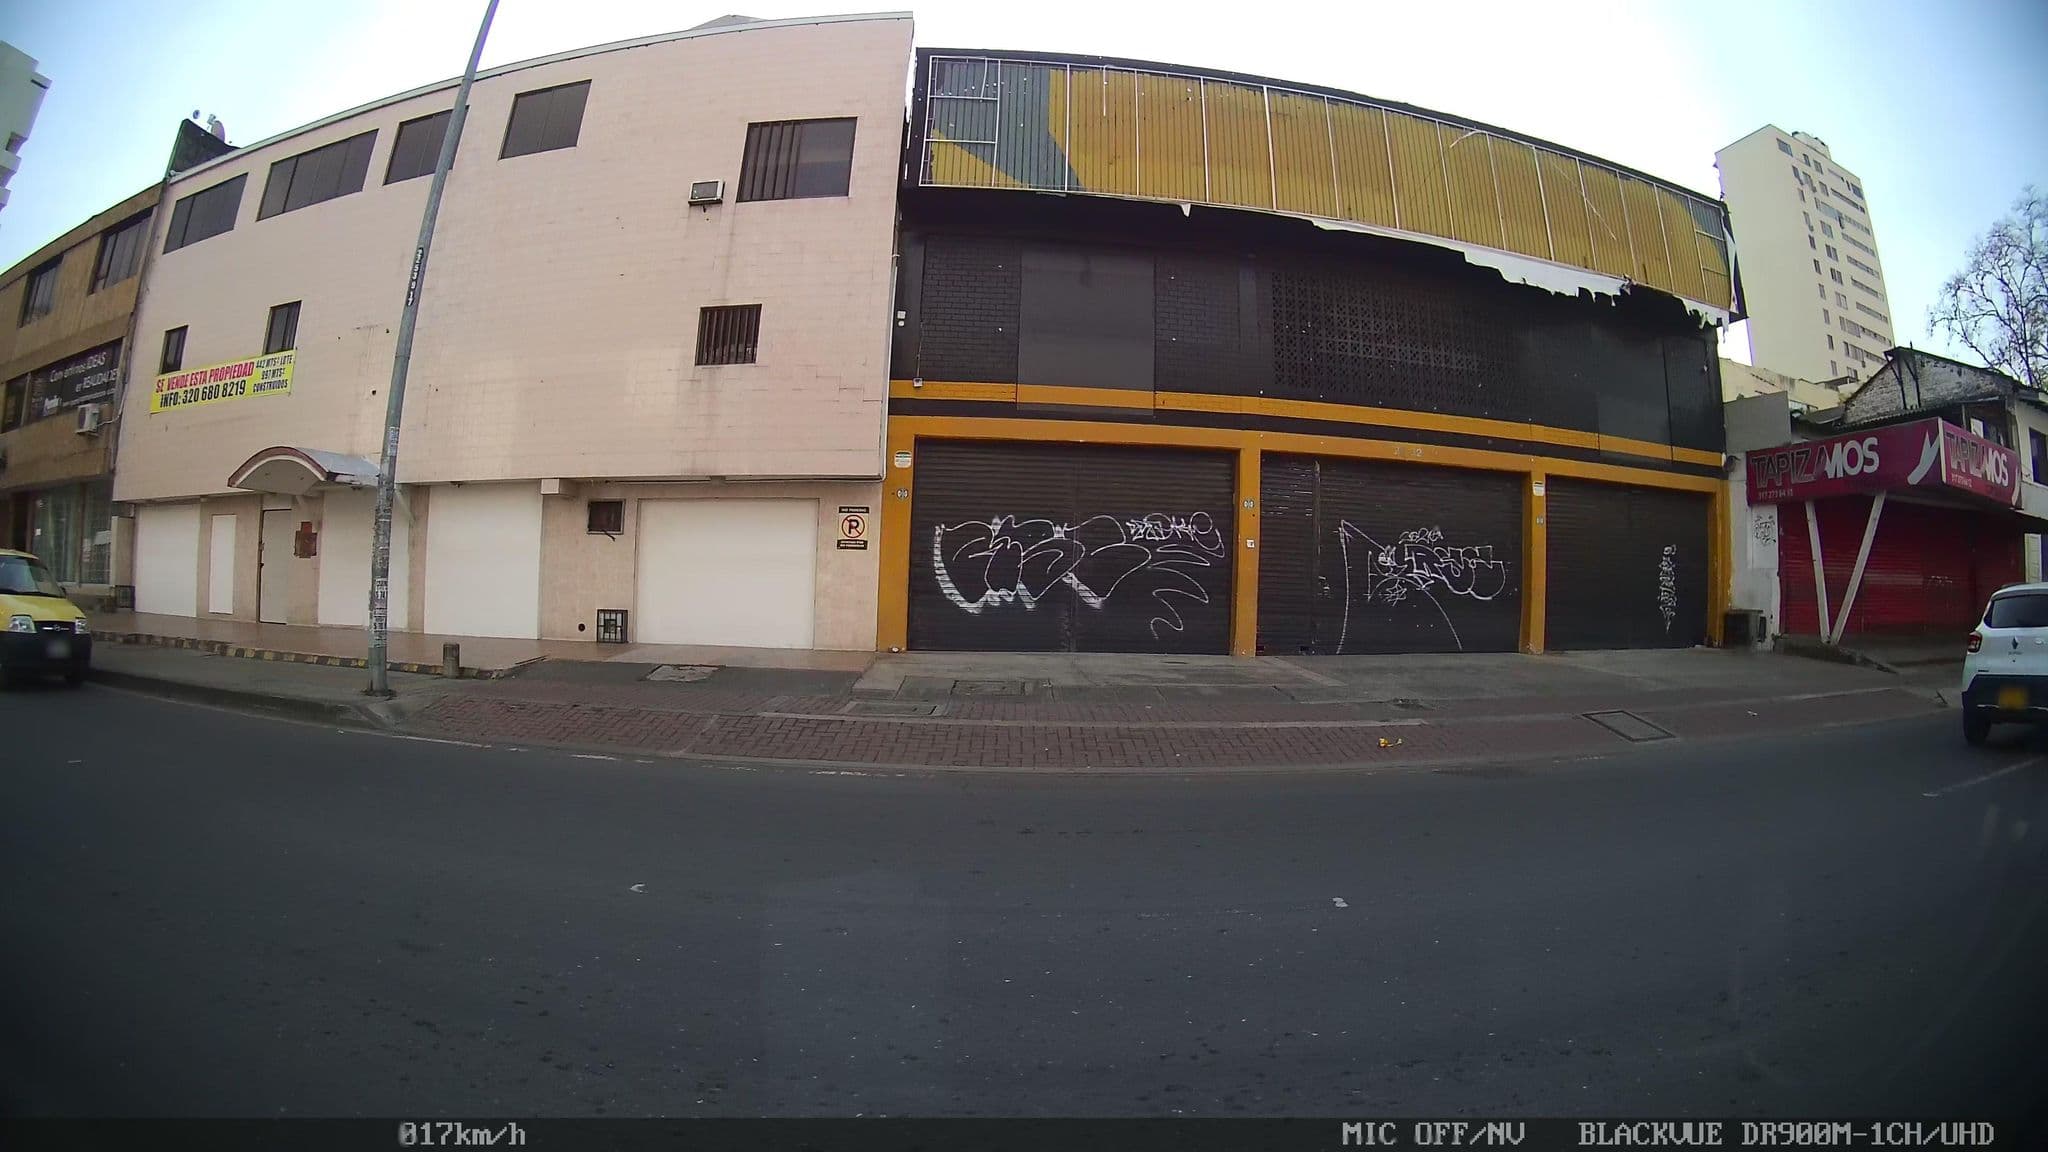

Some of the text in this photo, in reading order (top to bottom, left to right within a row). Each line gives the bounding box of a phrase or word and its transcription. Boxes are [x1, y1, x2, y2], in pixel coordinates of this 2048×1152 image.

[280, 354, 293, 365] LOTE
[156, 361, 255, 393] SE VENDE ESTA PROPIEDAD
[252, 378, 289, 394] CONSTRUIDOS
[160, 380, 247, 408] INFO: 320 680 8219
